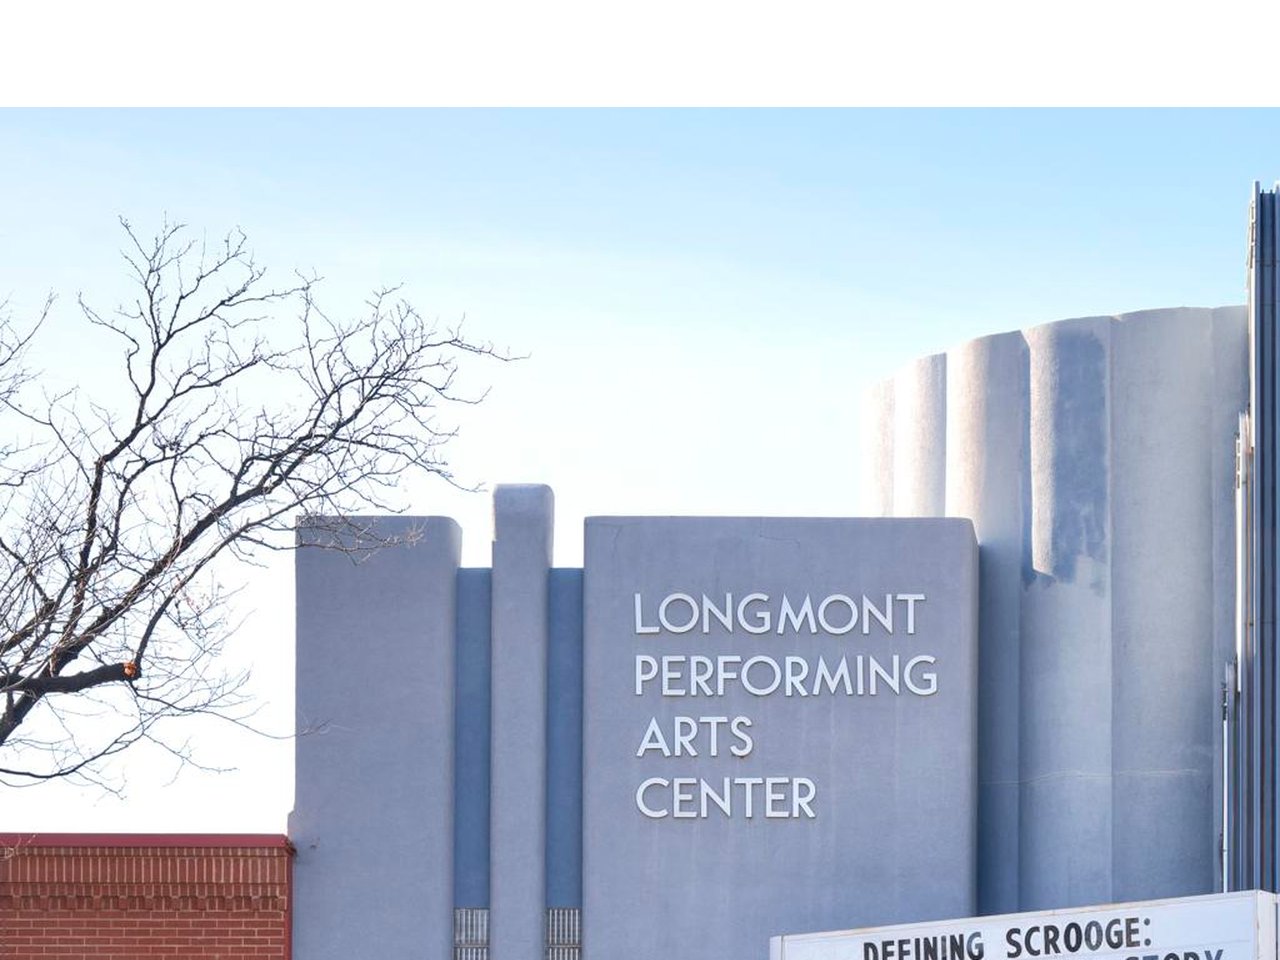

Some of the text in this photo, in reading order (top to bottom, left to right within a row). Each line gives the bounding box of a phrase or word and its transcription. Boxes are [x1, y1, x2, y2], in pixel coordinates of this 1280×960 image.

[634, 593, 925, 635] LONGMONT
[635, 655, 938, 697] PERFORMING
[636, 716, 754, 758] ARTS
[635, 776, 817, 819] CENTER
[1006, 917, 1151, 959] SCROOGE:
